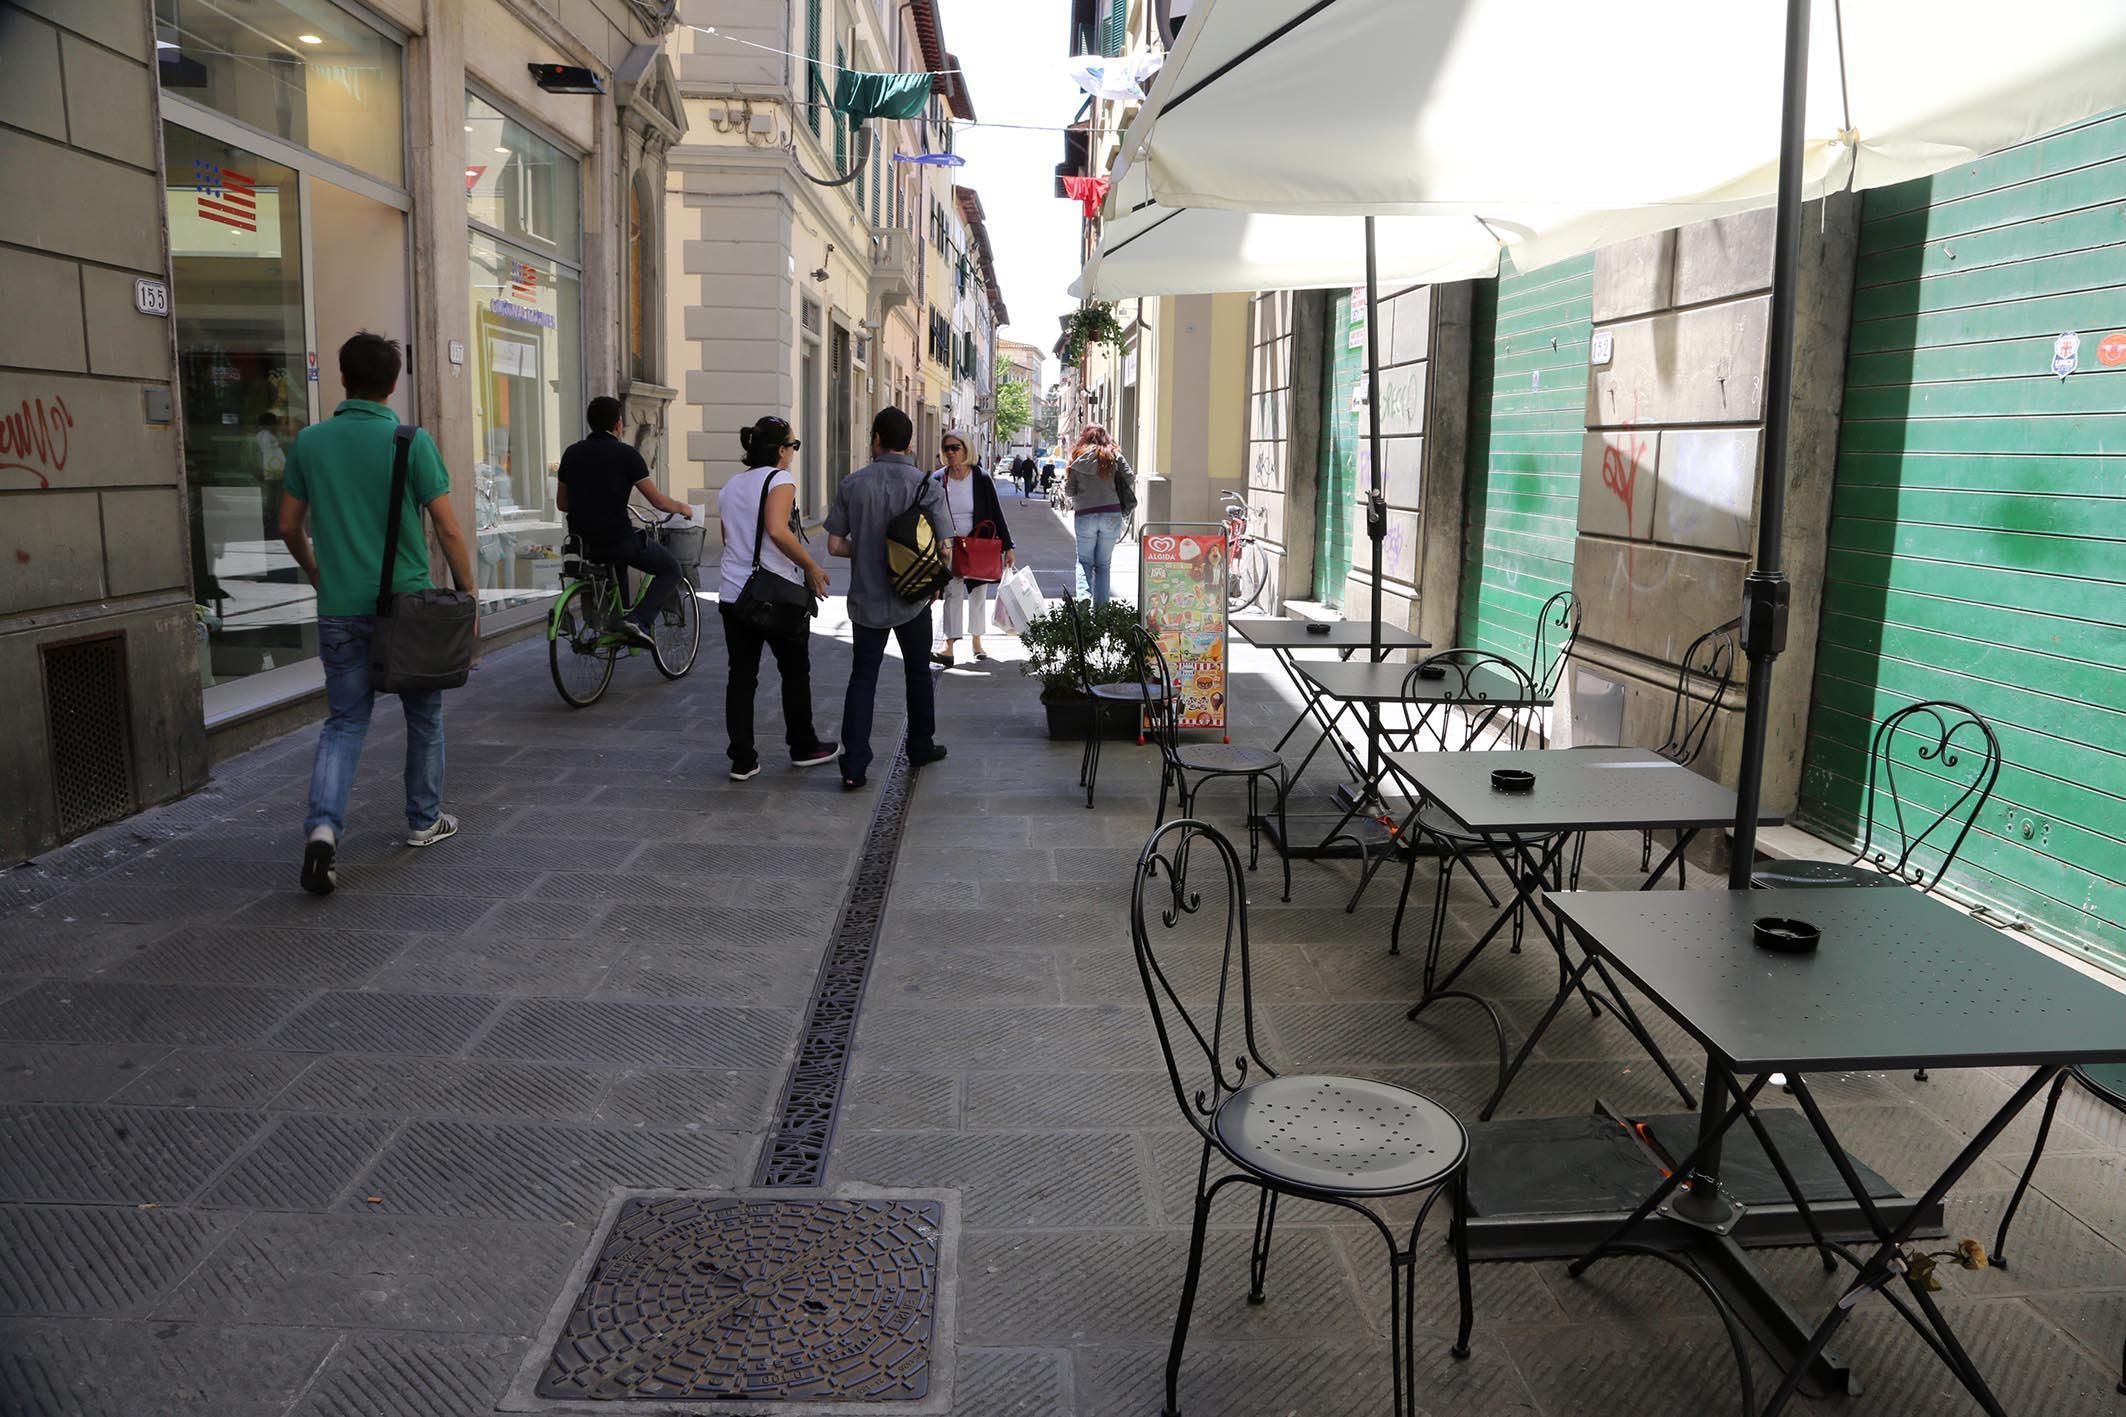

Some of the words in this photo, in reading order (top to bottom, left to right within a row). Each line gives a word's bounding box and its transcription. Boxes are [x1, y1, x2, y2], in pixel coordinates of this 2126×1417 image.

[141, 286, 165, 309] 155
[1593, 338, 1609, 359] 152
[1148, 553, 1175, 561] ALGIDA
